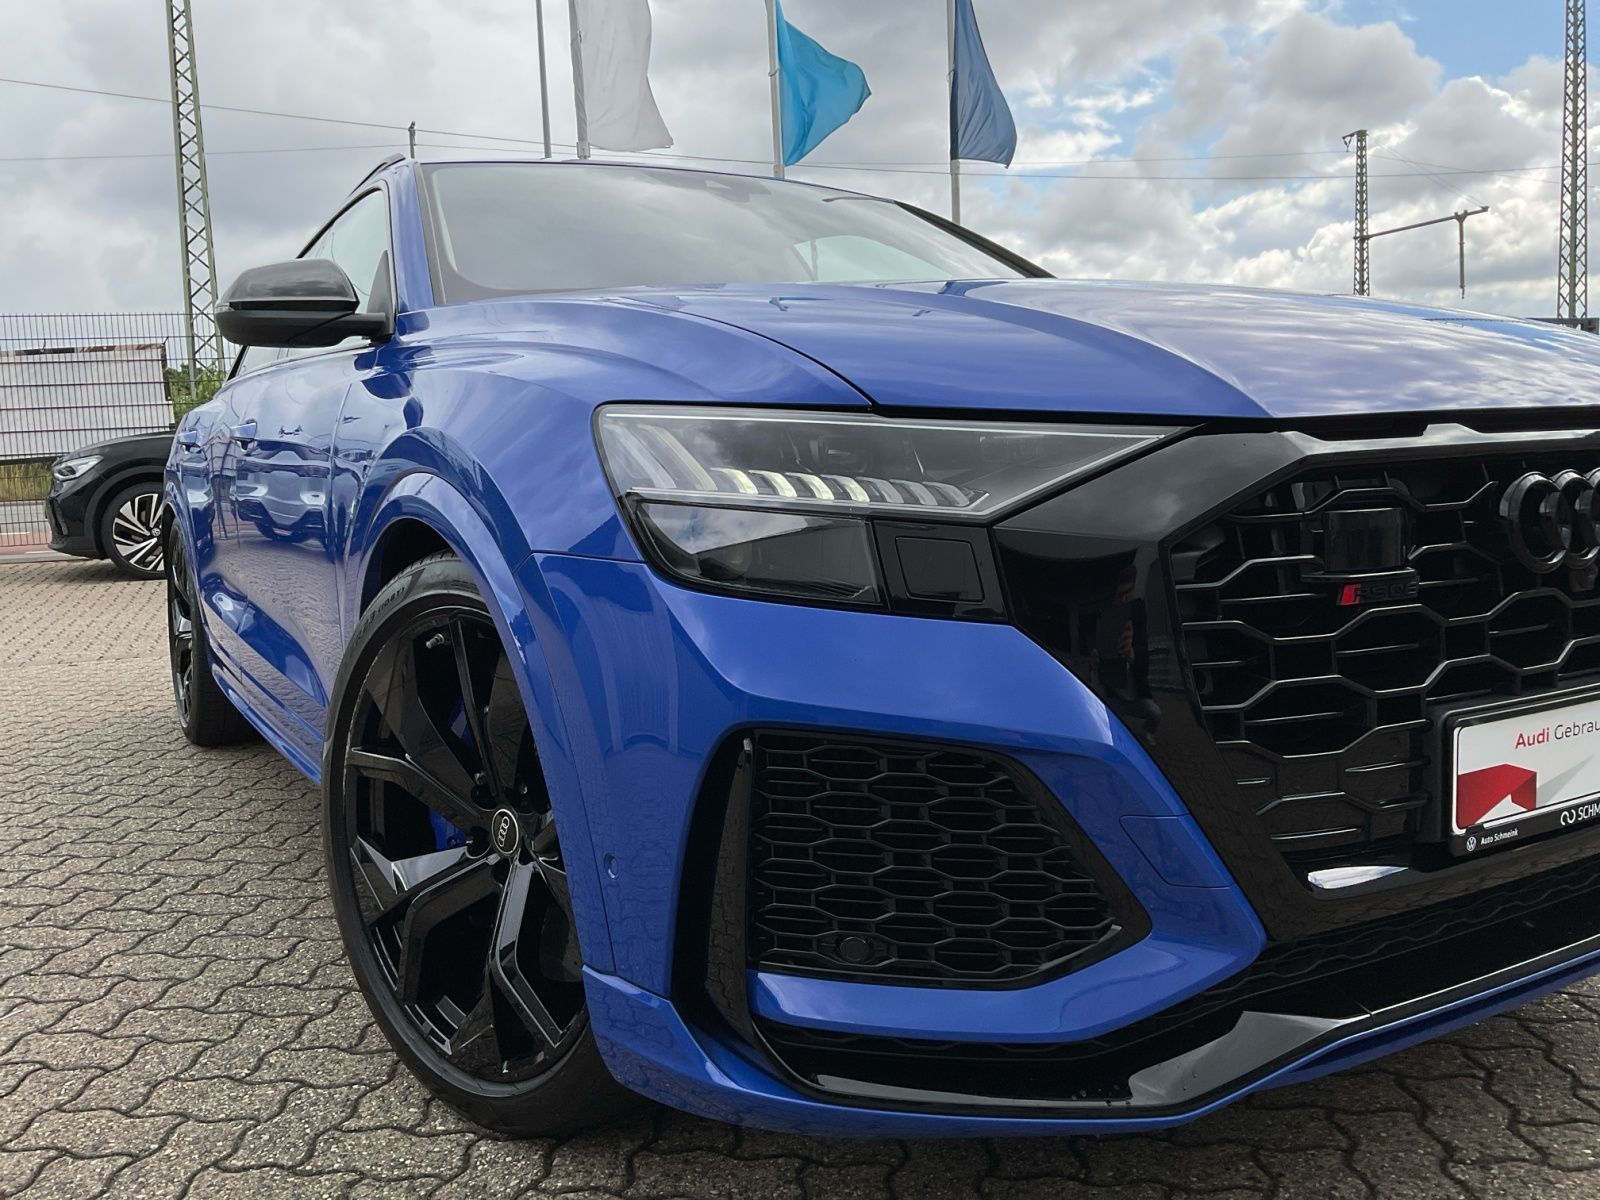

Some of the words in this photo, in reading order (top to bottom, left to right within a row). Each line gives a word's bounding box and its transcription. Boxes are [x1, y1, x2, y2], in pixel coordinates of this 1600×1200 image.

[1515, 727, 1550, 749] Audi
[1554, 719, 1600, 740] Gebrau
[1480, 836, 1494, 846] Auto
[1494, 828, 1519, 842] Schmeink
